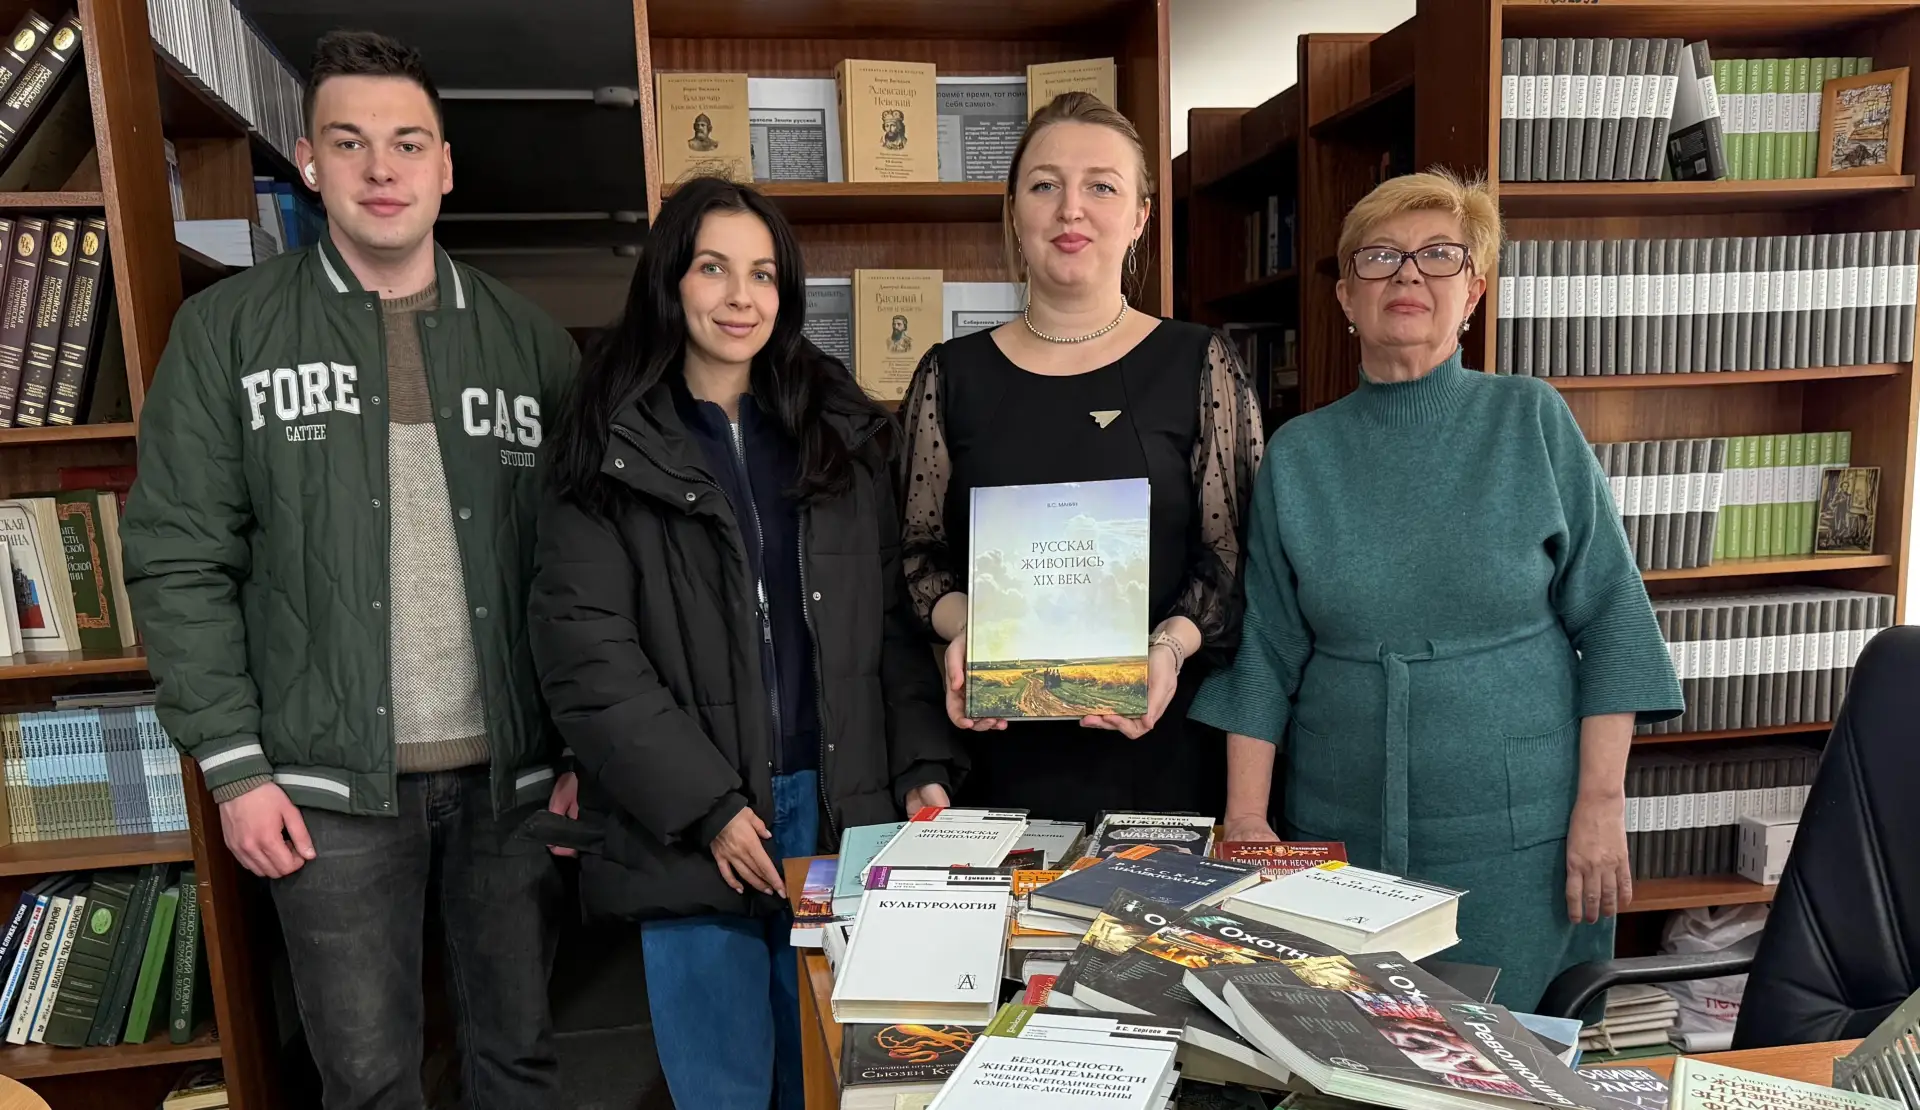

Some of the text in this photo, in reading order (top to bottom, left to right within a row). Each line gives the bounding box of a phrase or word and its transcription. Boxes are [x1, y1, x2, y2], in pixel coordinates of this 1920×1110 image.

[10, 278, 23, 328] ИСТОРИЧЕСКАЯ
[18, 279, 29, 324] РОССИЙСКАЯ
[43, 276, 56, 328] ИСТОРИЧЕСКАЯ
[50, 278, 62, 322] РОССИЙСКАЯ
[74, 276, 87, 327] ИСТОРИЧЕСКАЯ
[82, 278, 94, 322] РОССИЙСКАЯ
[241, 361, 361, 430] FORE
[461, 387, 543, 448] CAS
[285, 424, 326, 442] CATTEE
[500, 450, 535, 468] STUDIO
[1032, 540, 1094, 554] РУССКАЯ
[1021, 556, 1104, 570] ЖИВОПИСЬ
[1034, 573, 1092, 586] XIX ВЕКА
[1120, 832, 1188, 840] WARCRAFT
[1116, 862, 1217, 883] РУССКАЯ
[1272, 859, 1288, 867] ТРИ
[178, 884, 188, 936] DICCIONARIO
[878, 900, 997, 910] КУЛЬТУРОЛОГИЯ
[5, 925, 18, 948] СЛУЖБЕ
[14, 904, 27, 926] РОССИИ
[66, 906, 82, 939] ОКЕАНОВ
[28, 959, 44, 990] ВЕЛИКИЙ
[38, 942, 50, 958] ЧАС
[45, 906, 62, 940] ОКЕАНОВ
[61, 940, 72, 956] ЧАС
[51, 958, 66, 989] ВЕЛИКИЙ
[181, 978, 192, 1014] СЛОВАРЬ
[978, 1062, 1148, 1084] ЖИЗНЕДЕЯТЕЛЬНОСТИ
[1010, 1056, 1124, 1073] БЕЗОПАСНОСТЬ
[984, 1072, 1132, 1092] УЧЕБНО-МЕТОДИЧЕСКИЙ
[1692, 1073, 1707, 1081] О
[972, 1079, 1132, 1100] КОМПЛЕКС ДИСЦИПЛИНЫ
[1710, 1084, 1725, 1094] И
